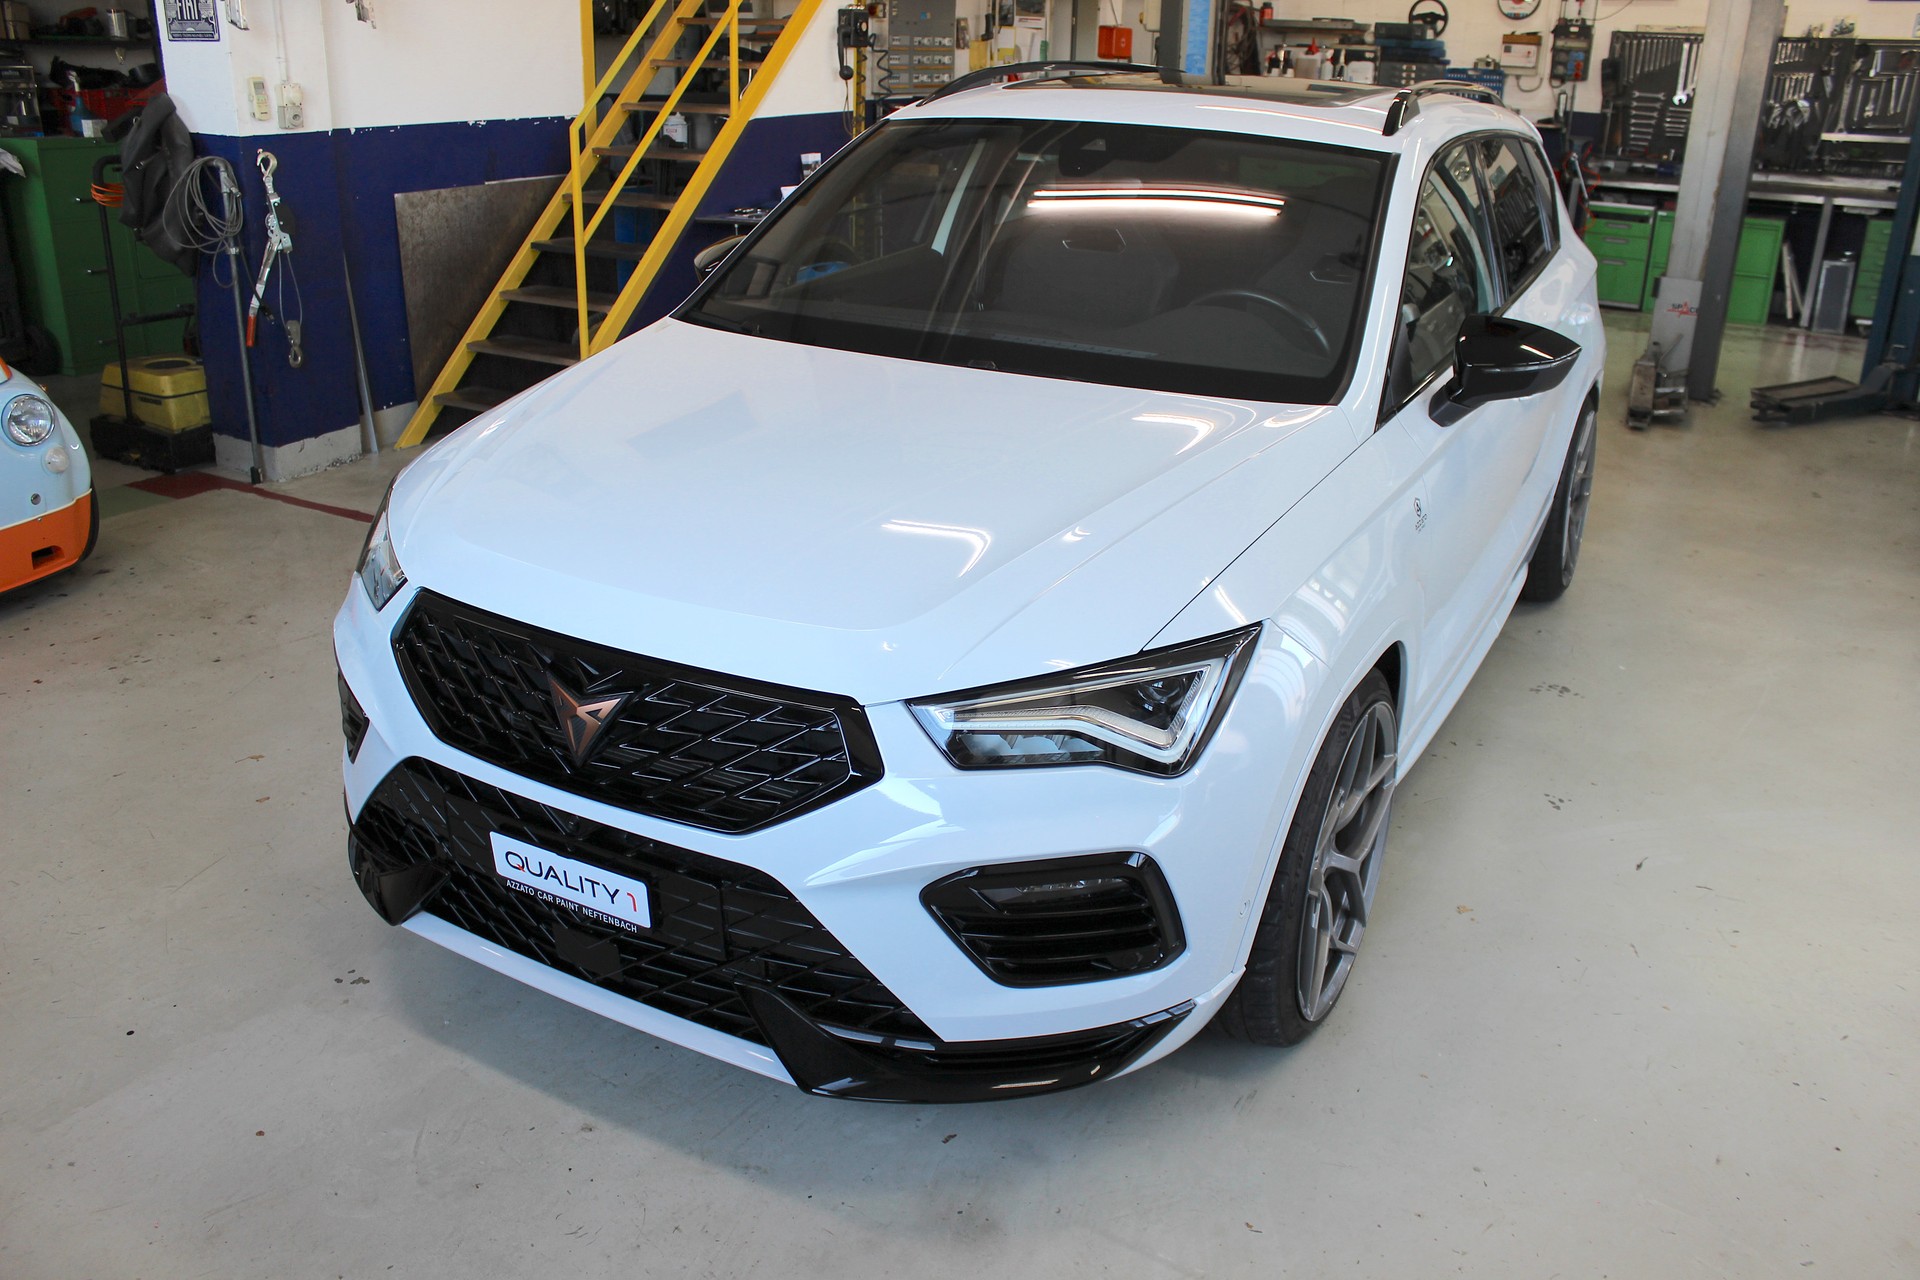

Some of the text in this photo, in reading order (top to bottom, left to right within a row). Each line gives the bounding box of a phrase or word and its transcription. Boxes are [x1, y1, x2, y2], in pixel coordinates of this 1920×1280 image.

[1671, 301, 1698, 315] SPAC
[505, 850, 620, 905] QUALITY
[506, 879, 638, 934] AZZATO CAR PAINT NEFTENBACH
